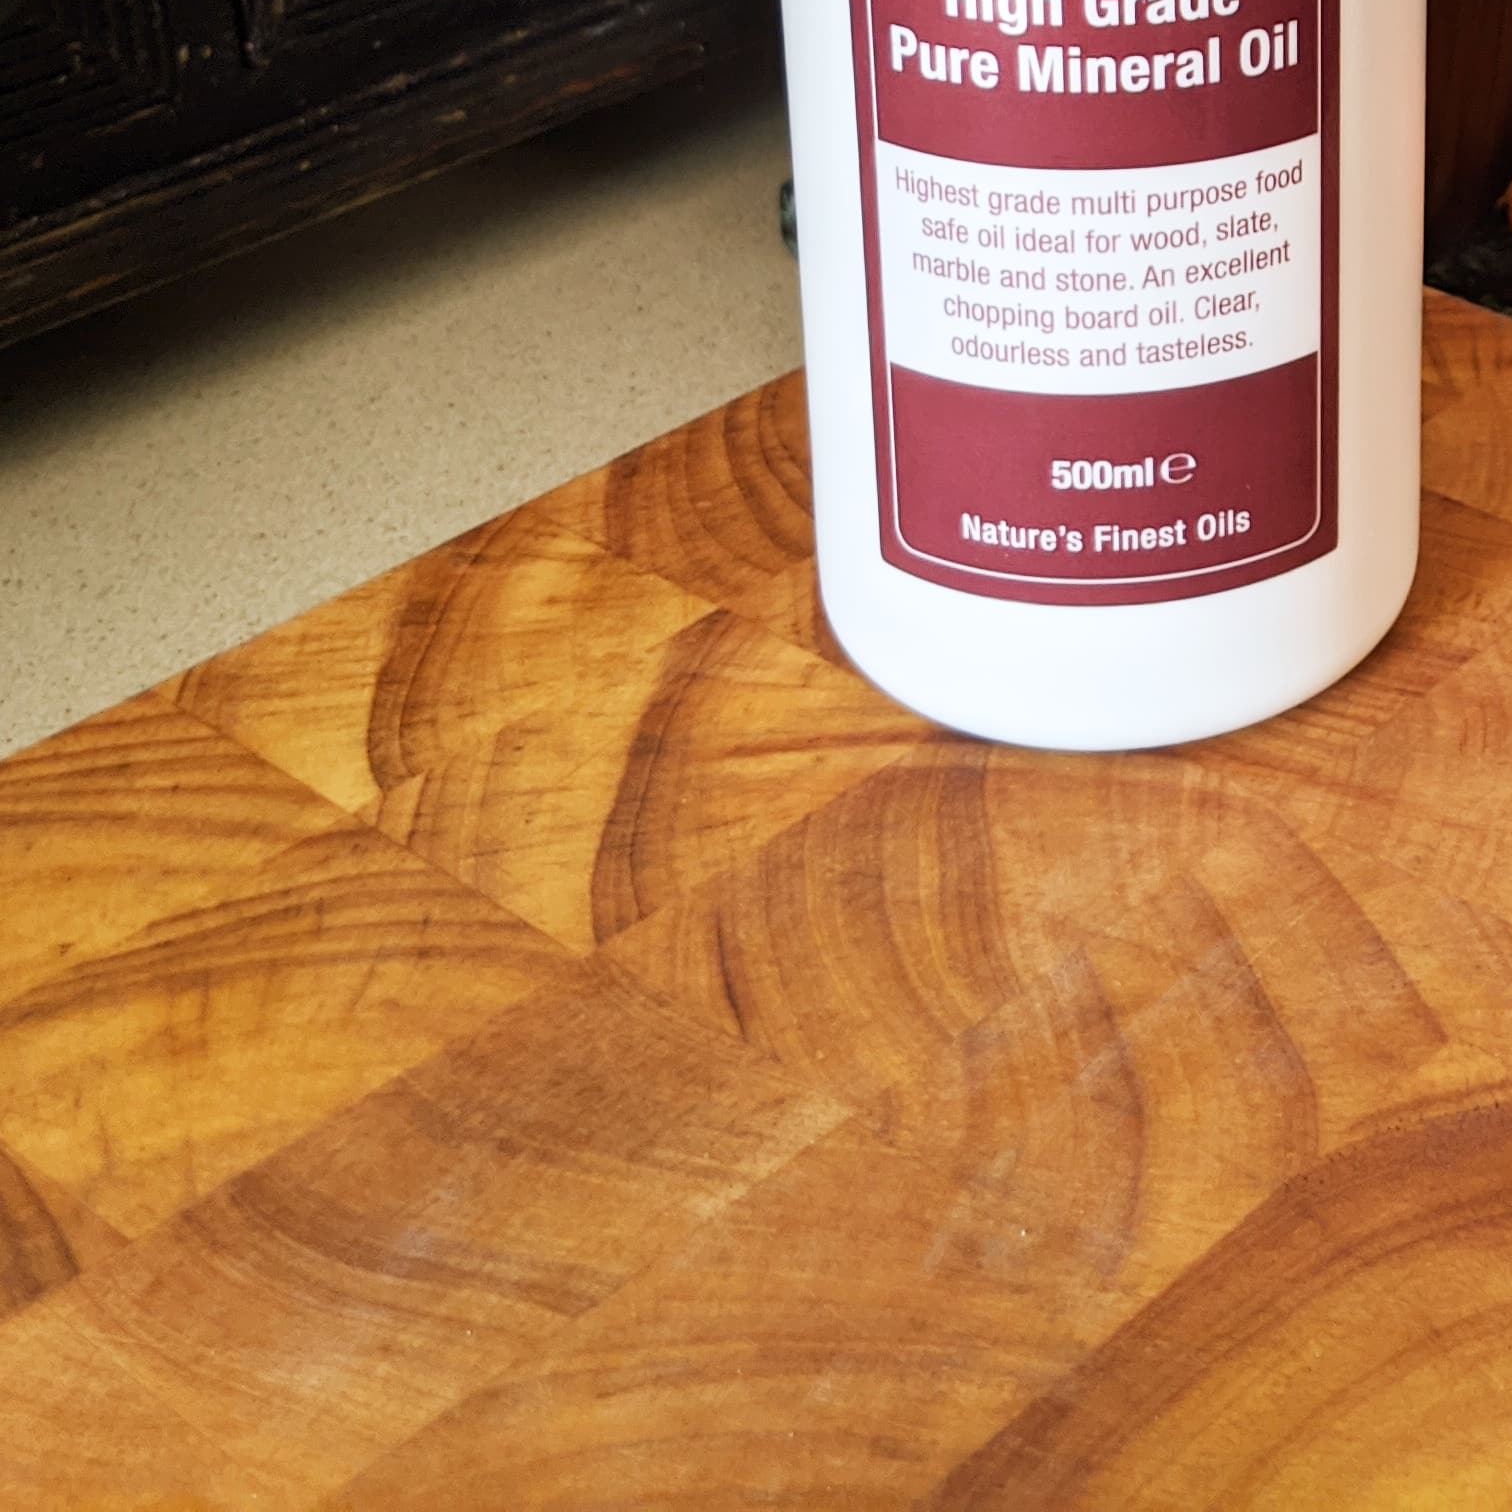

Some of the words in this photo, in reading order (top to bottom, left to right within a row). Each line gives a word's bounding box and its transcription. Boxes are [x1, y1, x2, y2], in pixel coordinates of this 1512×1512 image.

[890, 23, 999, 88] Pure
[1018, 37, 1220, 93] Mineral
[1240, 21, 1297, 76] Oil
[896, 167, 978, 207] Highest
[988, 190, 1060, 215] grade
[1072, 191, 1135, 215] multi
[1148, 181, 1247, 217] purpose
[1256, 160, 1302, 193] food
[922, 218, 968, 243] safe
[978, 225, 1004, 248] oil
[1016, 229, 1074, 253] ideal
[1086, 230, 1120, 253] for
[1131, 222, 1206, 251] wood,
[1217, 212, 1277, 240] slate,
[913, 253, 990, 285] marble
[1000, 268, 1045, 290] and
[1056, 269, 1134, 292] stone.
[1142, 266, 1174, 288] An
[1186, 240, 1290, 283] excellent
[944, 295, 1054, 334] chopping
[1066, 304, 1138, 329] board
[1149, 301, 1184, 326] oil.
[1195, 291, 1259, 319] Clear,
[952, 336, 1069, 366] odourless
[1080, 343, 1126, 367] and
[1137, 331, 1253, 364] tasteless.
[1052, 458, 1153, 489] 500ml
[962, 513, 1082, 552] Nature's
[1094, 520, 1186, 552] Finest
[1197, 510, 1250, 541] Oils
